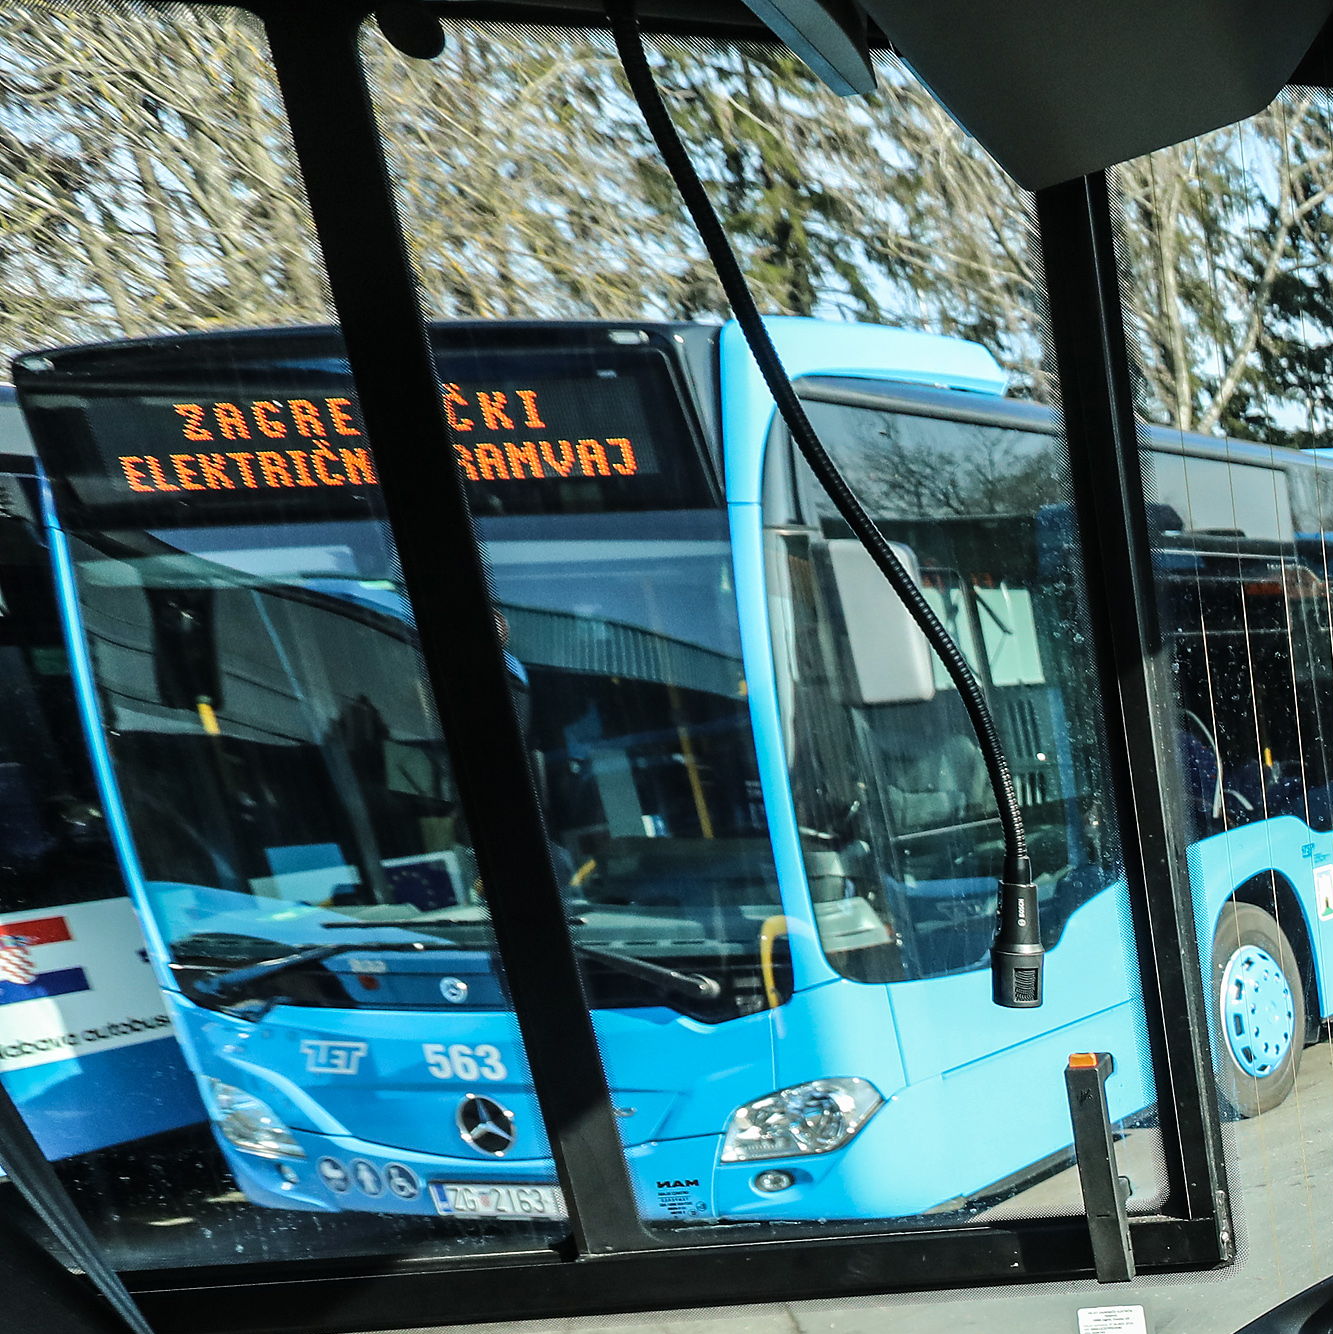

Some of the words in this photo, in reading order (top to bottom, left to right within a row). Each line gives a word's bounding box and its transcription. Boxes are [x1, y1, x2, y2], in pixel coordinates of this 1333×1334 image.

[118, 440, 379, 492] ELEKTRIČN
[452, 437, 638, 482] RAMVAJ
[301, 1039, 368, 1075] ZET
[422, 1043, 508, 1082] 563
[446, 1187, 478, 1212] ZG
